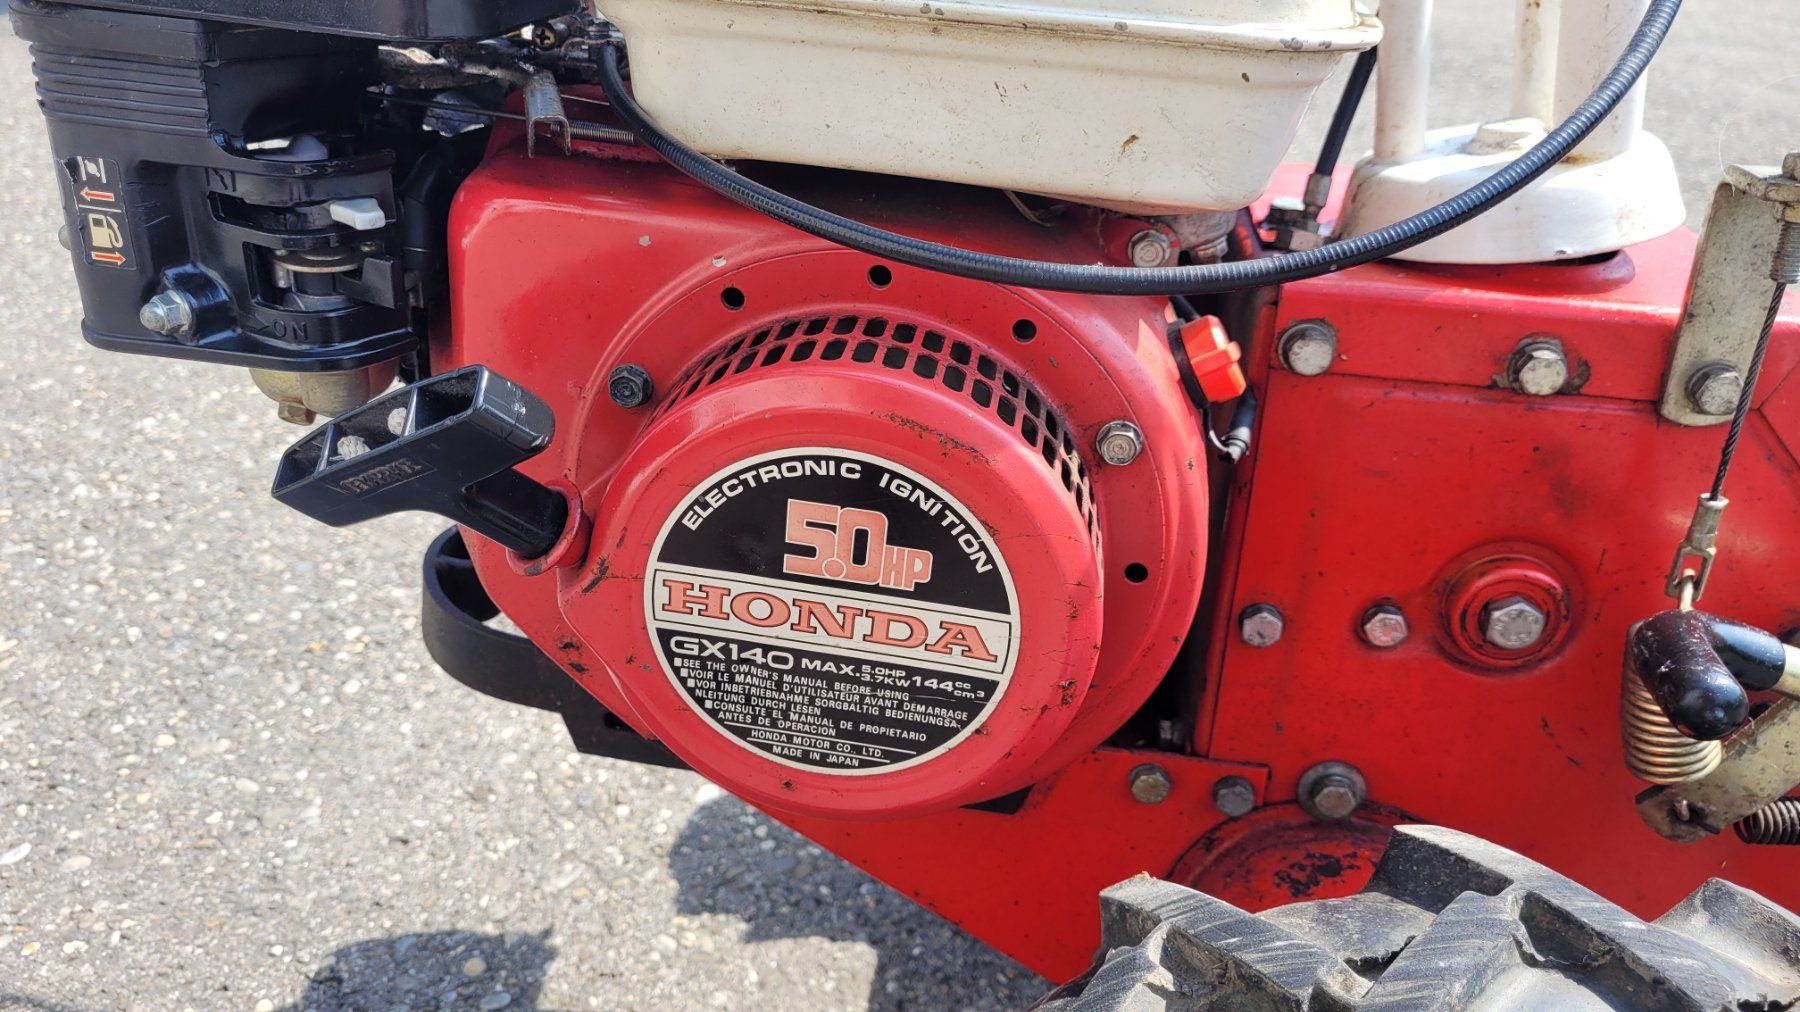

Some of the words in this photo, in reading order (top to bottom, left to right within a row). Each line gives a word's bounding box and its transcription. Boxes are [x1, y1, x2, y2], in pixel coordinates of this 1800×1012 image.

[273, 319, 308, 341] ON
[682, 460, 861, 531] ELECTRONIC
[879, 472, 993, 574] IGNITION
[661, 579, 998, 663] HONDA
[670, 635, 794, 670] GX140
[801, 658, 861, 677] MAX.
[861, 664, 906, 677] 5.0HP
[912, 676, 954, 692] 144
[954, 681, 972, 690] cc
[683, 658, 701, 669] SEE
[706, 661, 726, 672] THE
[731, 664, 779, 681] OWNER'S
[783, 673, 828, 689] MANUAL
[834, 682, 871, 695] BEFORE
[877, 688, 910, 701] USING
[689, 669, 714, 680] VOIR
[718, 672, 729, 682] LE
[735, 673, 777, 690] MANUEL
[783, 683, 864, 702] D'UTILISATEUR
[863, 696, 899, 708] AVANT
[903, 702, 968, 721] DEMARRAGE
[695, 688, 745, 703] NLEITUNG
[751, 697, 786, 710] DURCH
[791, 704, 821, 715] LESEN
[696, 679, 717, 690] VOR
[720, 683, 810, 705] INBETRIEBNAHME
[714, 700, 766, 716] CONSULTE
[772, 709, 783, 719] EL
[789, 712, 834, 728] MANUAL
[839, 721, 853, 730] DE
[859, 723, 927, 742] PROPIETARIO
[718, 712, 752, 723] ANTES
[758, 716, 770, 726] DE
[777, 719, 836, 737] OPERACION
[751, 729, 787, 743] HONDA
[792, 735, 830, 750] MOTOR
[862, 747, 885, 758] LTD.
[772, 745, 803, 757] MADE
[809, 751, 821, 760] IN
[827, 755, 860, 767] JAPAN
